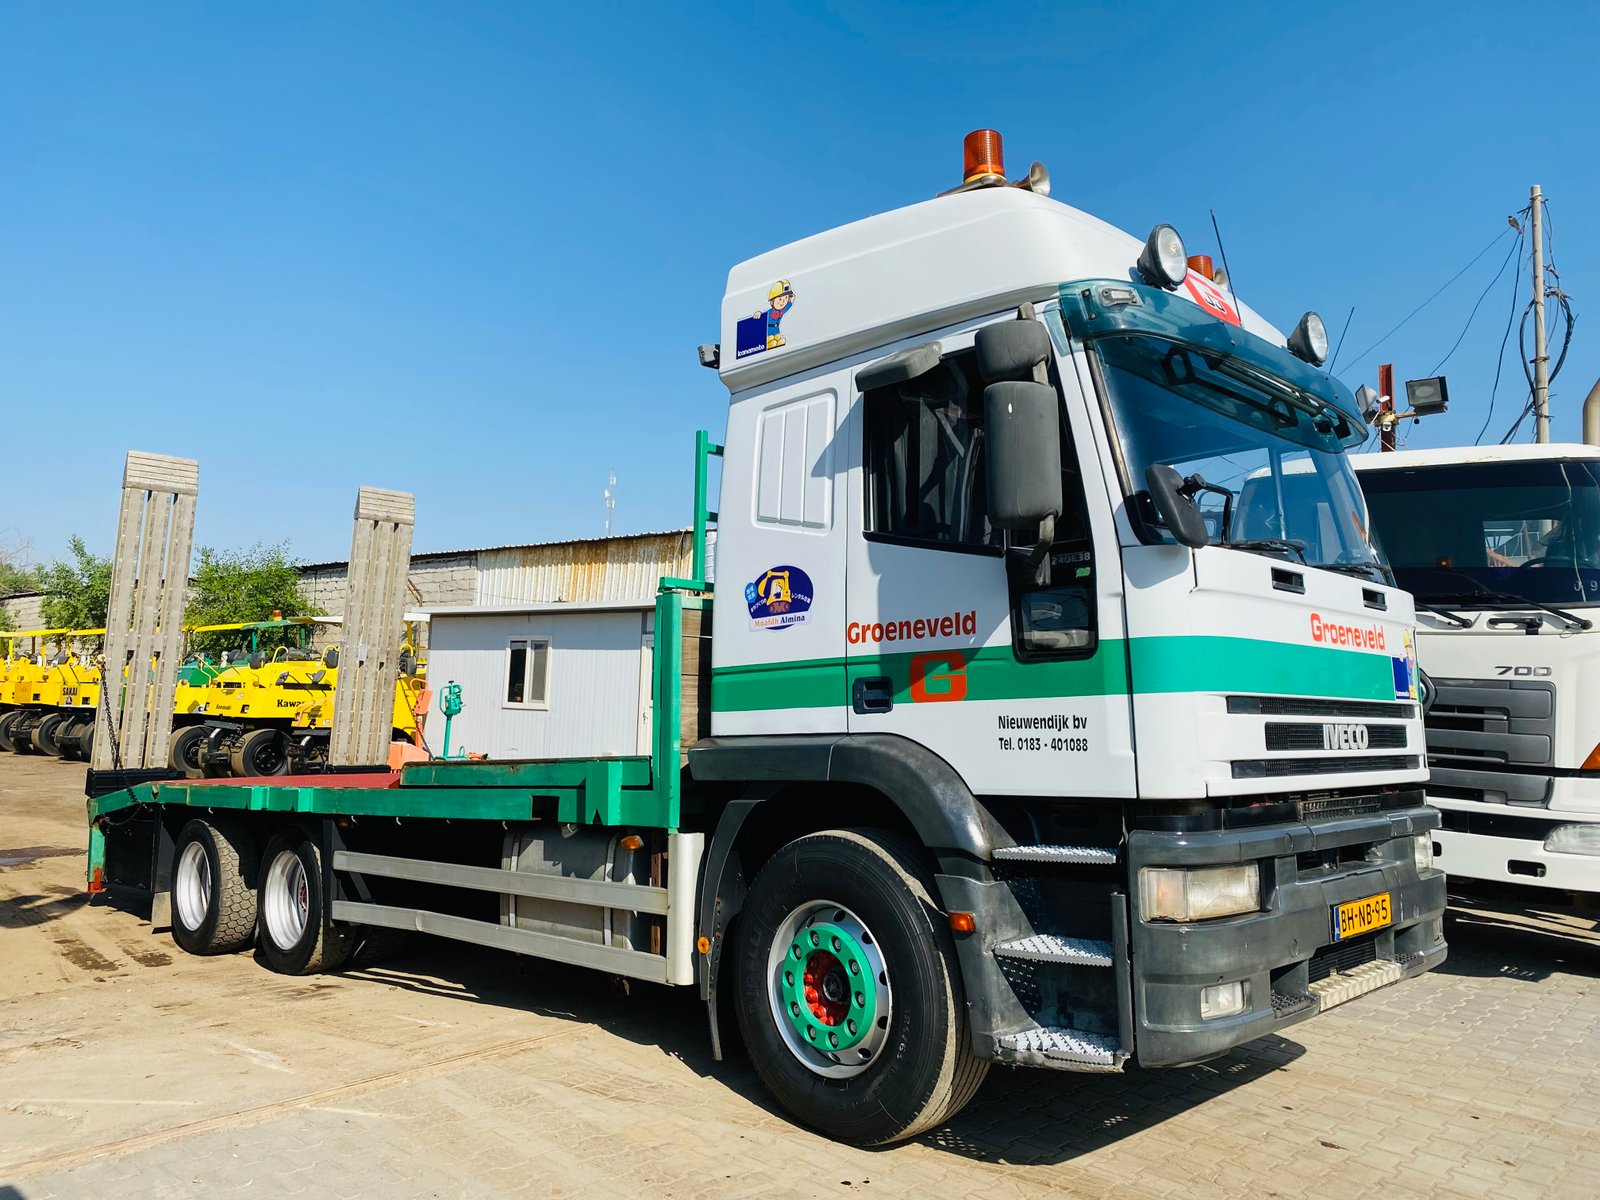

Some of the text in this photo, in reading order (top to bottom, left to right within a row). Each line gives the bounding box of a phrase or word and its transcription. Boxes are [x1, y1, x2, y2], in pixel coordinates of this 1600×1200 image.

[780, 614, 805, 624] Almina
[847, 610, 977, 645] Groeneveld
[1311, 613, 1386, 651] Groeneveld
[1494, 665, 1553, 676] 700
[62, 686, 78, 696] SAKAI
[998, 715, 1088, 732] Nieuwendijk bv
[998, 737, 1015, 751] Tel.
[1017, 737, 1041, 751] 0183
[1050, 737, 1089, 752] 401088
[1323, 723, 1369, 750] IVECO
[1341, 899, 1388, 932] BH-NB-95
